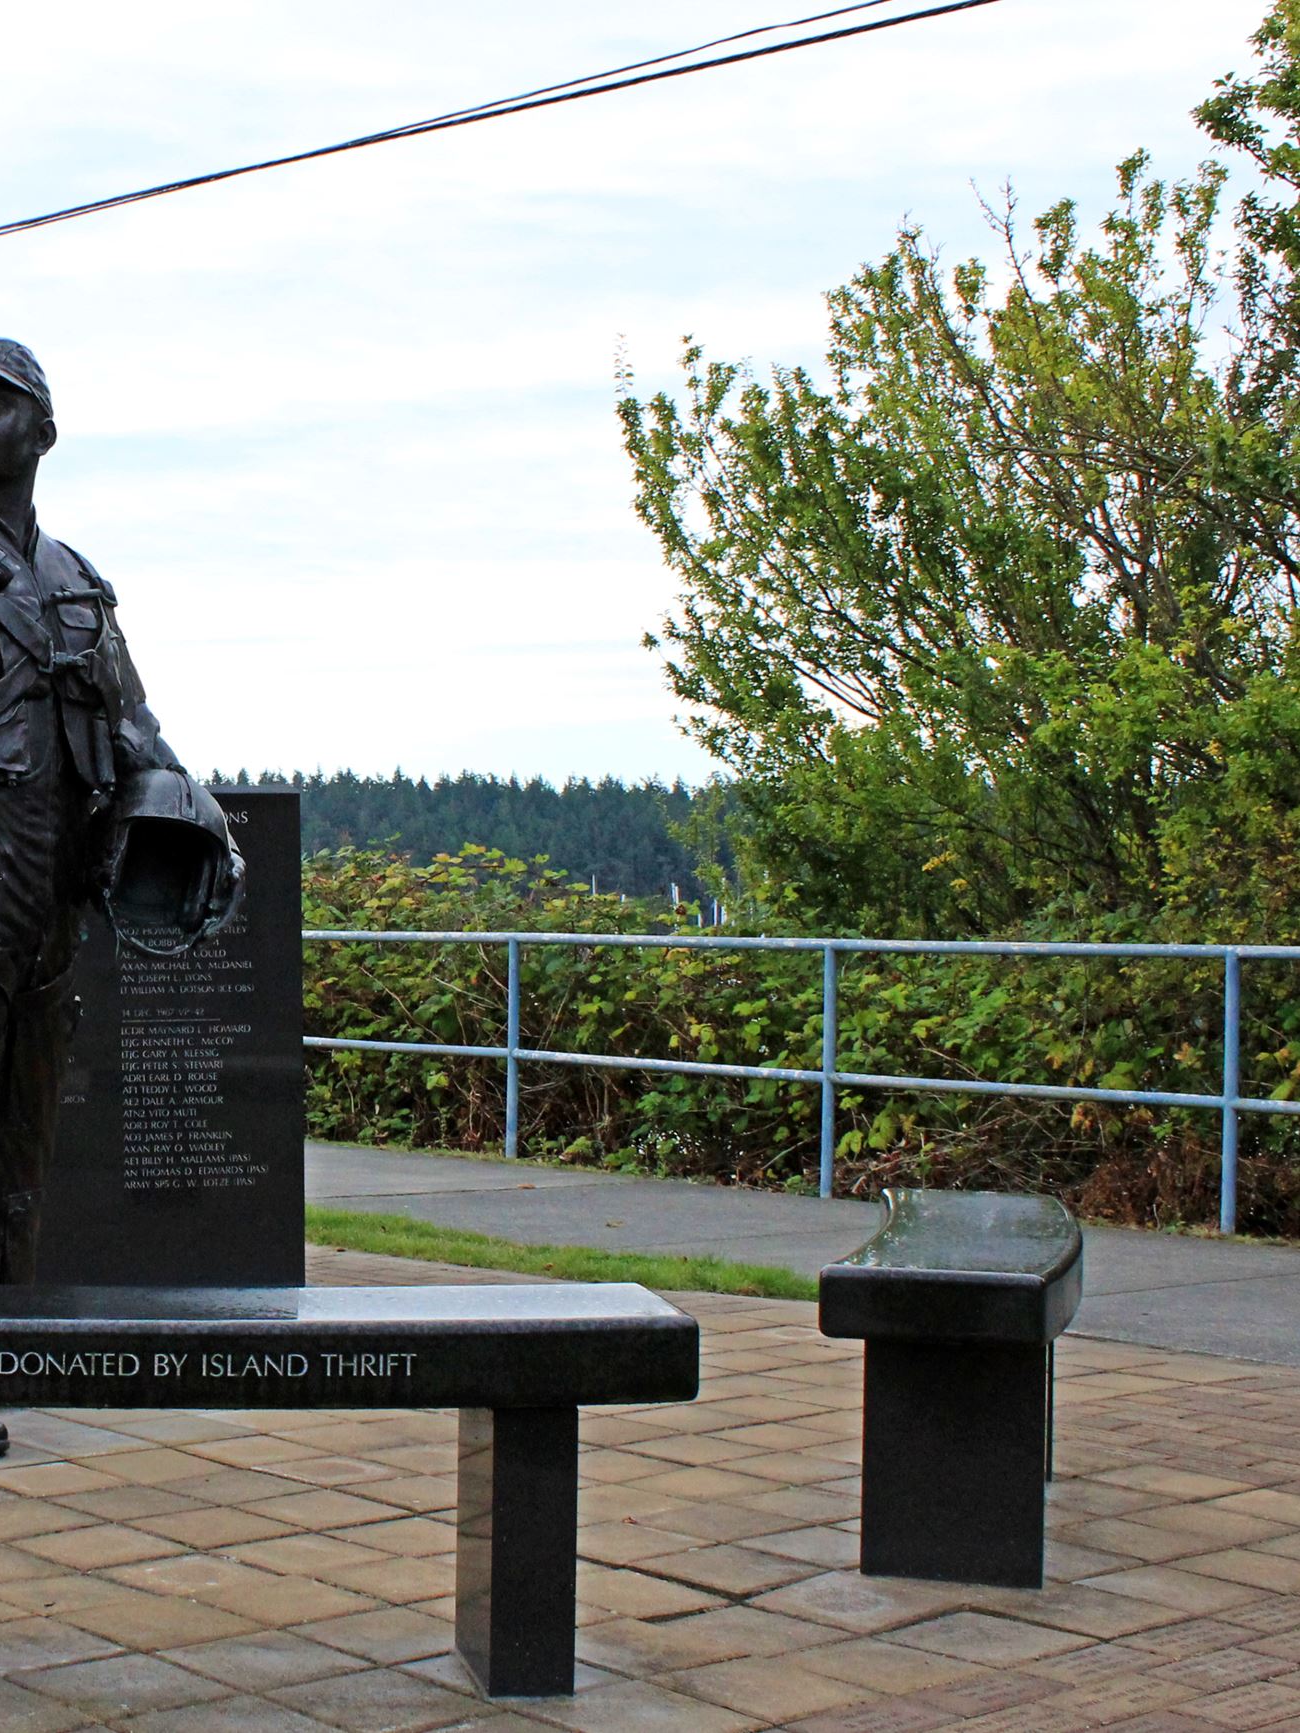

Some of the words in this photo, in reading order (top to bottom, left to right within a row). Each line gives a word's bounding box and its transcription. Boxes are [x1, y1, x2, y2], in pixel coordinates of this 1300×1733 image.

[120, 962, 148, 970] AXAN
[150, 962, 191, 970] MICHAEL
[137, 974, 171, 982] JOSEPH
[184, 973, 213, 981] LYONS
[120, 1027, 145, 1035] LCDR
[148, 1026, 195, 1034] MAYNARD
[208, 1024, 252, 1033] HOWARD
[120, 1038, 140, 1047] LTJG
[142, 1037, 185, 1046] KENNETH
[201, 1036, 235, 1044] McCOY
[120, 1050, 140, 1059] LTJG
[141, 1049, 168, 1058] GARY
[183, 1048, 220, 1057] KLESSIG
[121, 1061, 140, 1071] LTJG
[142, 1061, 169, 1070] PETER
[183, 1060, 224, 1069] STEWART
[122, 1073, 147, 1082] ADR1
[148, 1073, 171, 1081] EARL
[187, 1072, 218, 1080] ROUSE
[121, 1085, 138, 1094] AT1
[140, 1085, 170, 1093] TEDDY
[184, 1083, 218, 1092] WOOD
[142, 1097, 165, 1105] DALE
[181, 1095, 224, 1104] ARMOUR
[148, 1108, 171, 1117] VITO
[150, 1120, 170, 1128] ROY
[183, 1119, 208, 1128] COLE
[144, 1132, 174, 1141] JAMES
[188, 1130, 233, 1140] FRANKLIN
[123, 1145, 151, 1153] AXAN
[153, 1144, 172, 1152] RAY
[188, 1142, 226, 1151] WADLEY
[141, 1156, 164, 1165] BILLY
[228, 1153, 252, 1161] (PAS)
[141, 1167, 182, 1176] THOMAS
[198, 1165, 244, 1174] EDWARDS
[246, 1165, 269, 1173] (PAS)
[153, 1353, 187, 1376] BY
[201, 1353, 308, 1376] ISLAND
[320, 1353, 417, 1376] THRIFT
